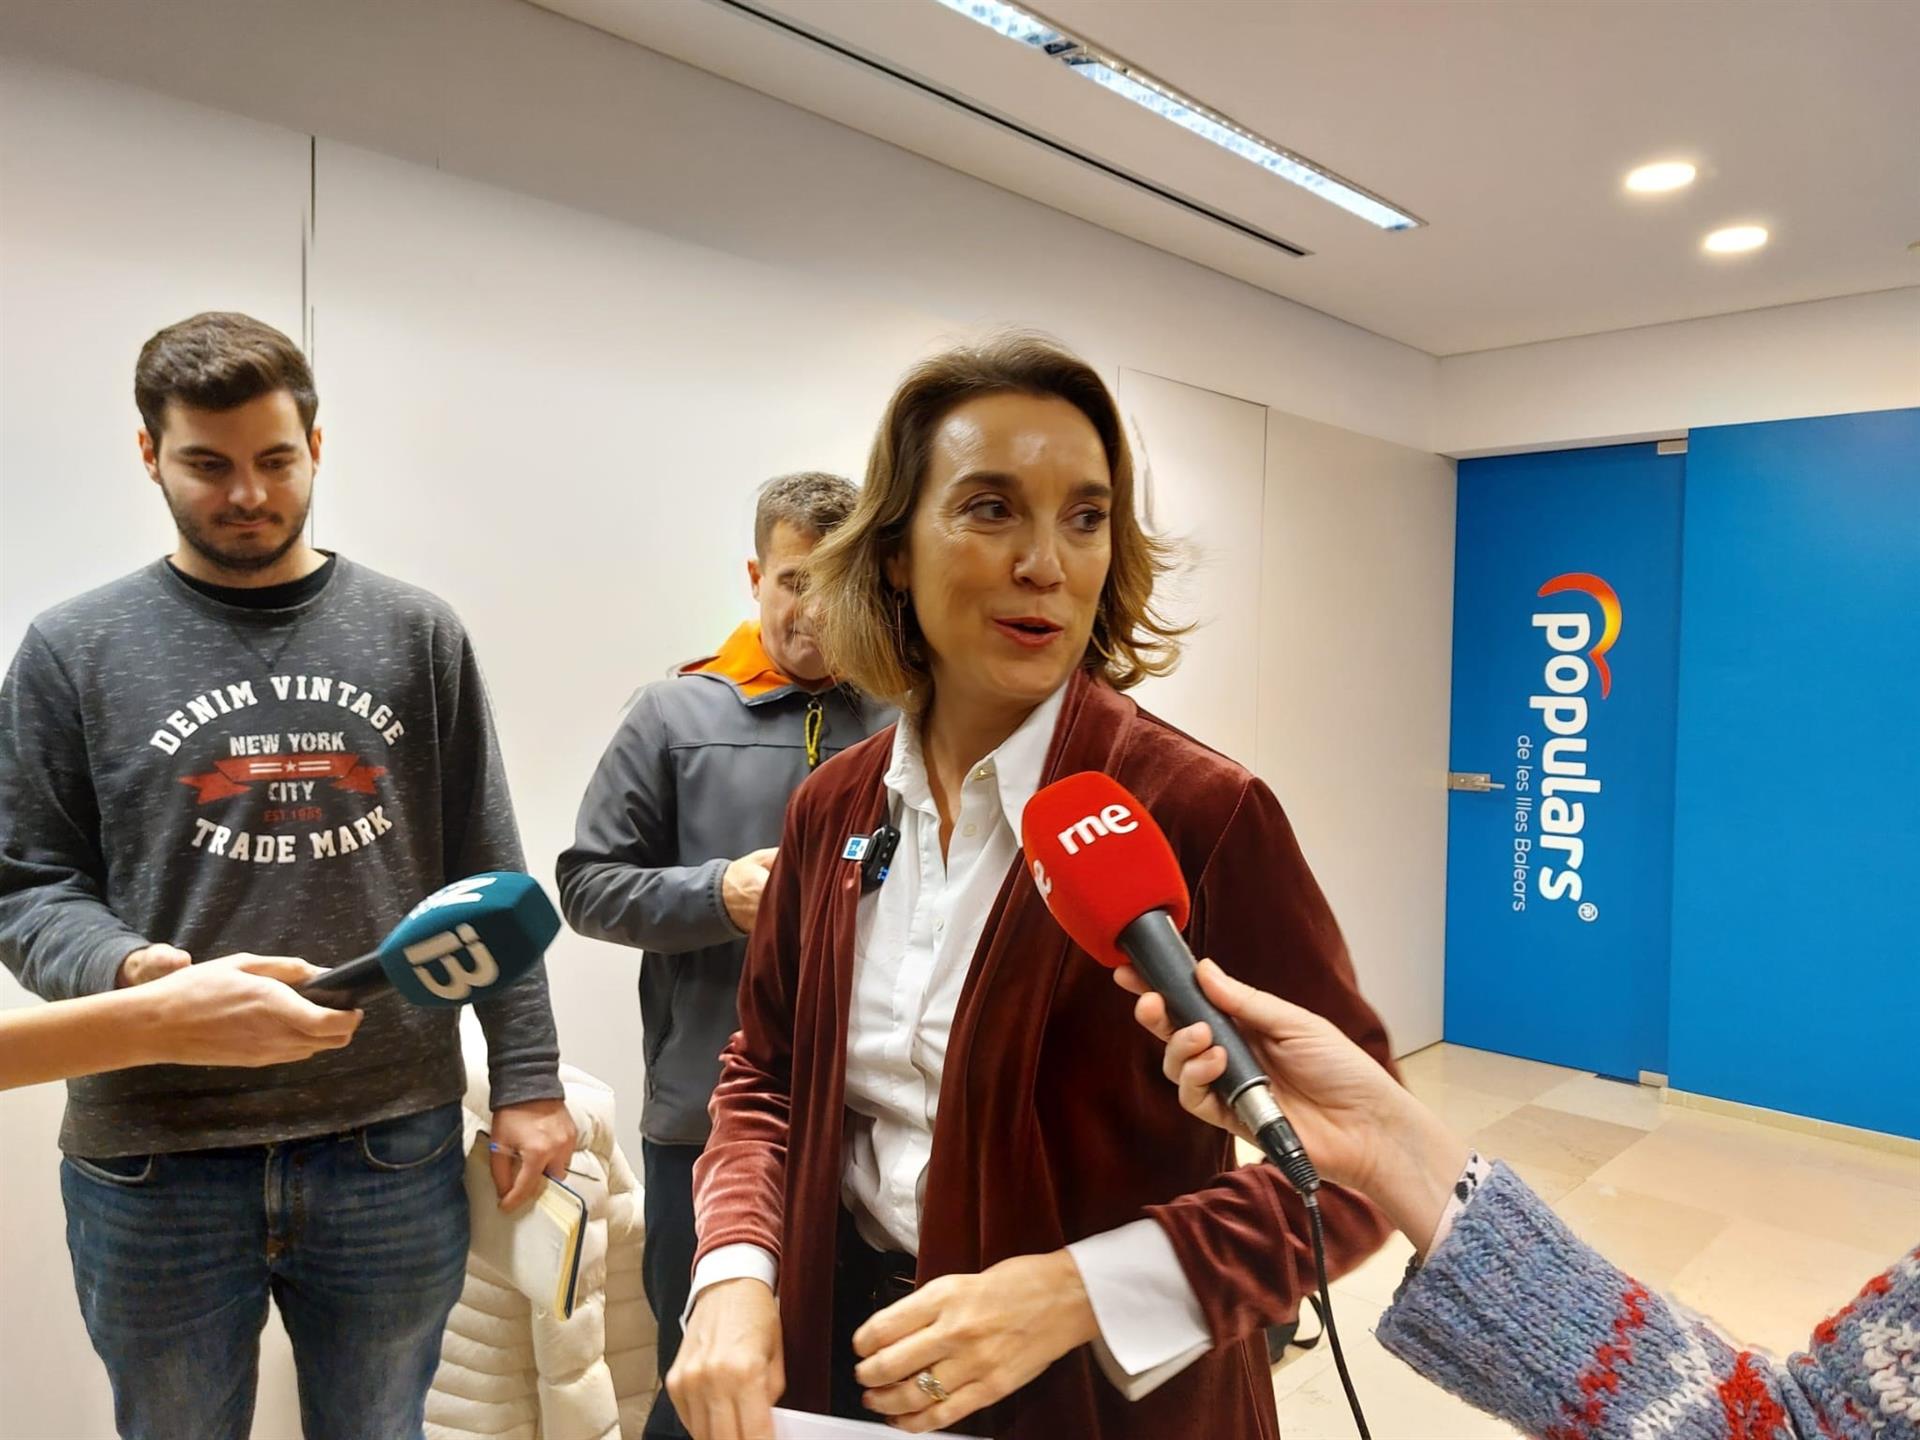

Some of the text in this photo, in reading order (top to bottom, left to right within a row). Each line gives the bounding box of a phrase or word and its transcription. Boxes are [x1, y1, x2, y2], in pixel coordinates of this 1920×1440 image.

[149, 675, 405, 756] DENIM VINTAGE
[230, 732, 346, 756] NEW YORK
[268, 781, 315, 803] CITY
[191, 805, 393, 864] TRADE MARK
[1057, 803, 1139, 856] rne
[1512, 734, 1533, 912] de les Illes Balears
